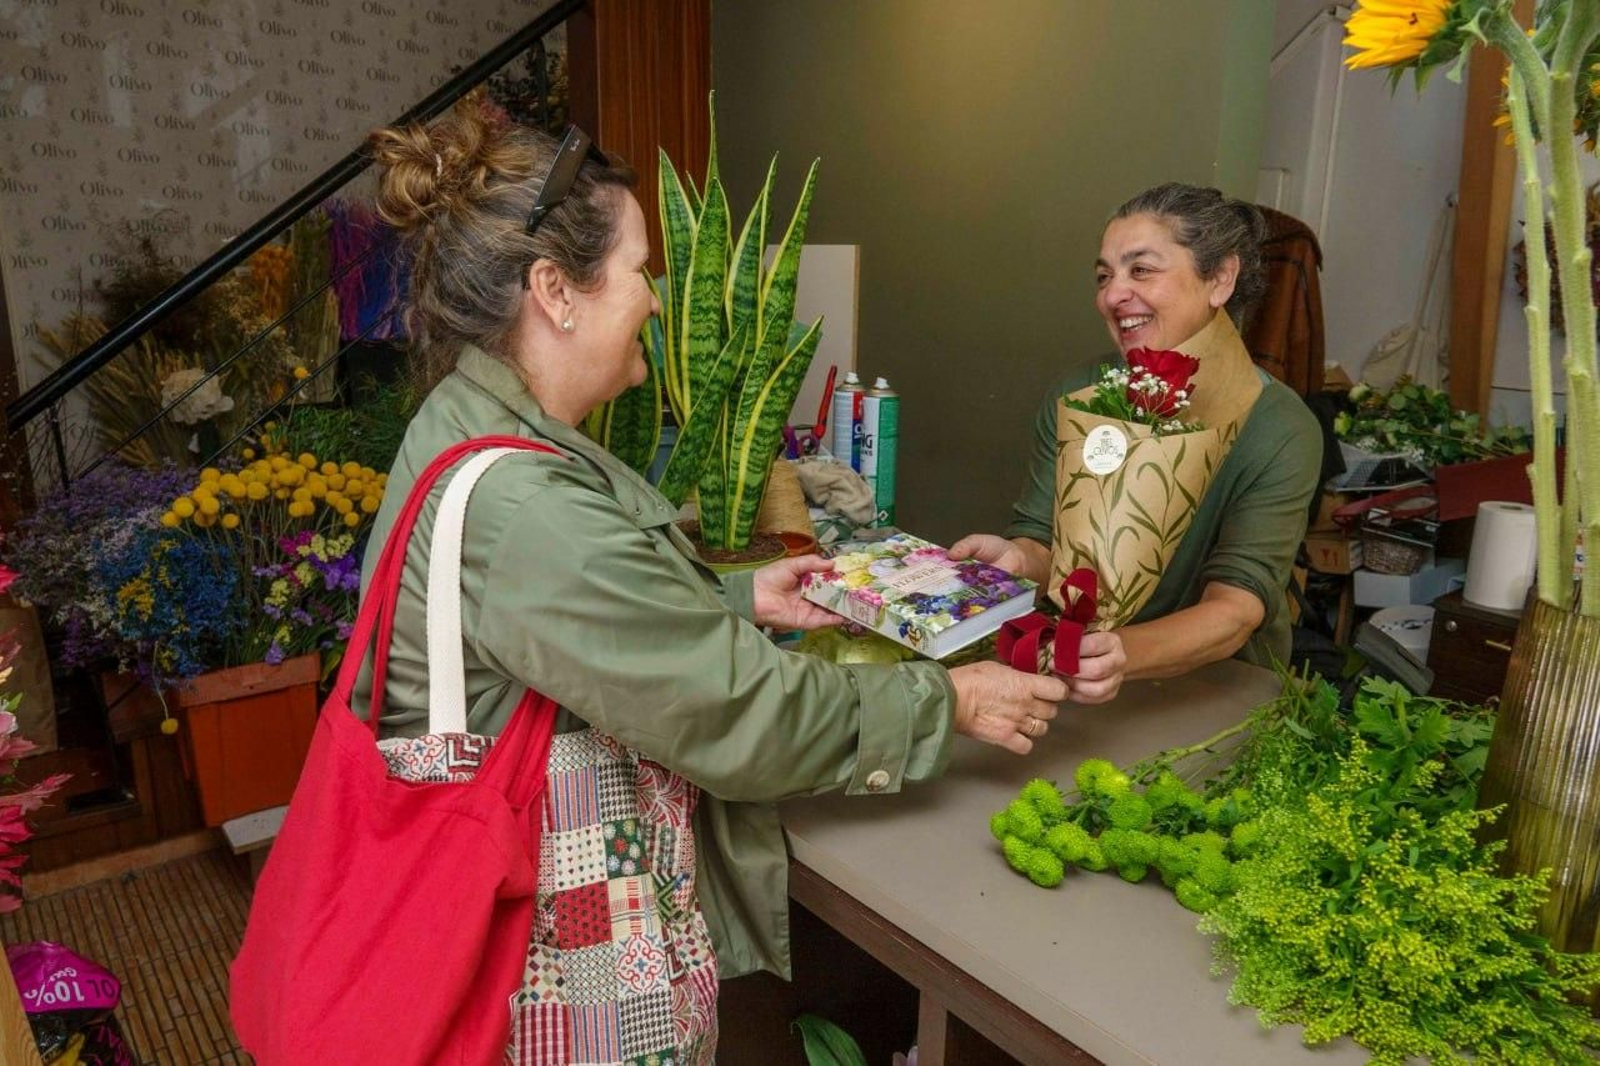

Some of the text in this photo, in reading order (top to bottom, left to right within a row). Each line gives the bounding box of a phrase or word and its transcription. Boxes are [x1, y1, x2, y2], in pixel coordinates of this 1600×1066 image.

[100, 0, 144, 17] Olivo
[361, 1, 397, 18] Olivo
[182, 10, 223, 28] Olivo
[426, 10, 459, 27] Olivo
[259, 20, 297, 38] Olivo
[60, 31, 107, 50] Olivo
[330, 30, 366, 46] Olivo
[146, 41, 188, 60] Olivo
[396, 39, 430, 55] Olivo
[224, 50, 265, 68] Olivo
[298, 59, 335, 76] Olivo
[20, 65, 68, 84] Olivo
[109, 74, 152, 91] Olivo
[366, 67, 400, 83] Olivo
[190, 81, 230, 99] Olivo
[265, 89, 303, 106] Olivo
[335, 97, 371, 112] Olivo
[70, 107, 115, 124] Olivo
[154, 114, 196, 131] Olivo
[232, 121, 270, 137] Olivo
[303, 126, 341, 141] Olivo
[31, 141, 77, 159] Olivo
[117, 148, 160, 164] Olivo
[197, 153, 237, 168] Olivo
[271, 158, 308, 173] Olivo
[80, 180, 124, 197] Olivo
[162, 185, 203, 200] Olivo
[238, 190, 276, 204] Olivo
[41, 215, 86, 232] Olivo
